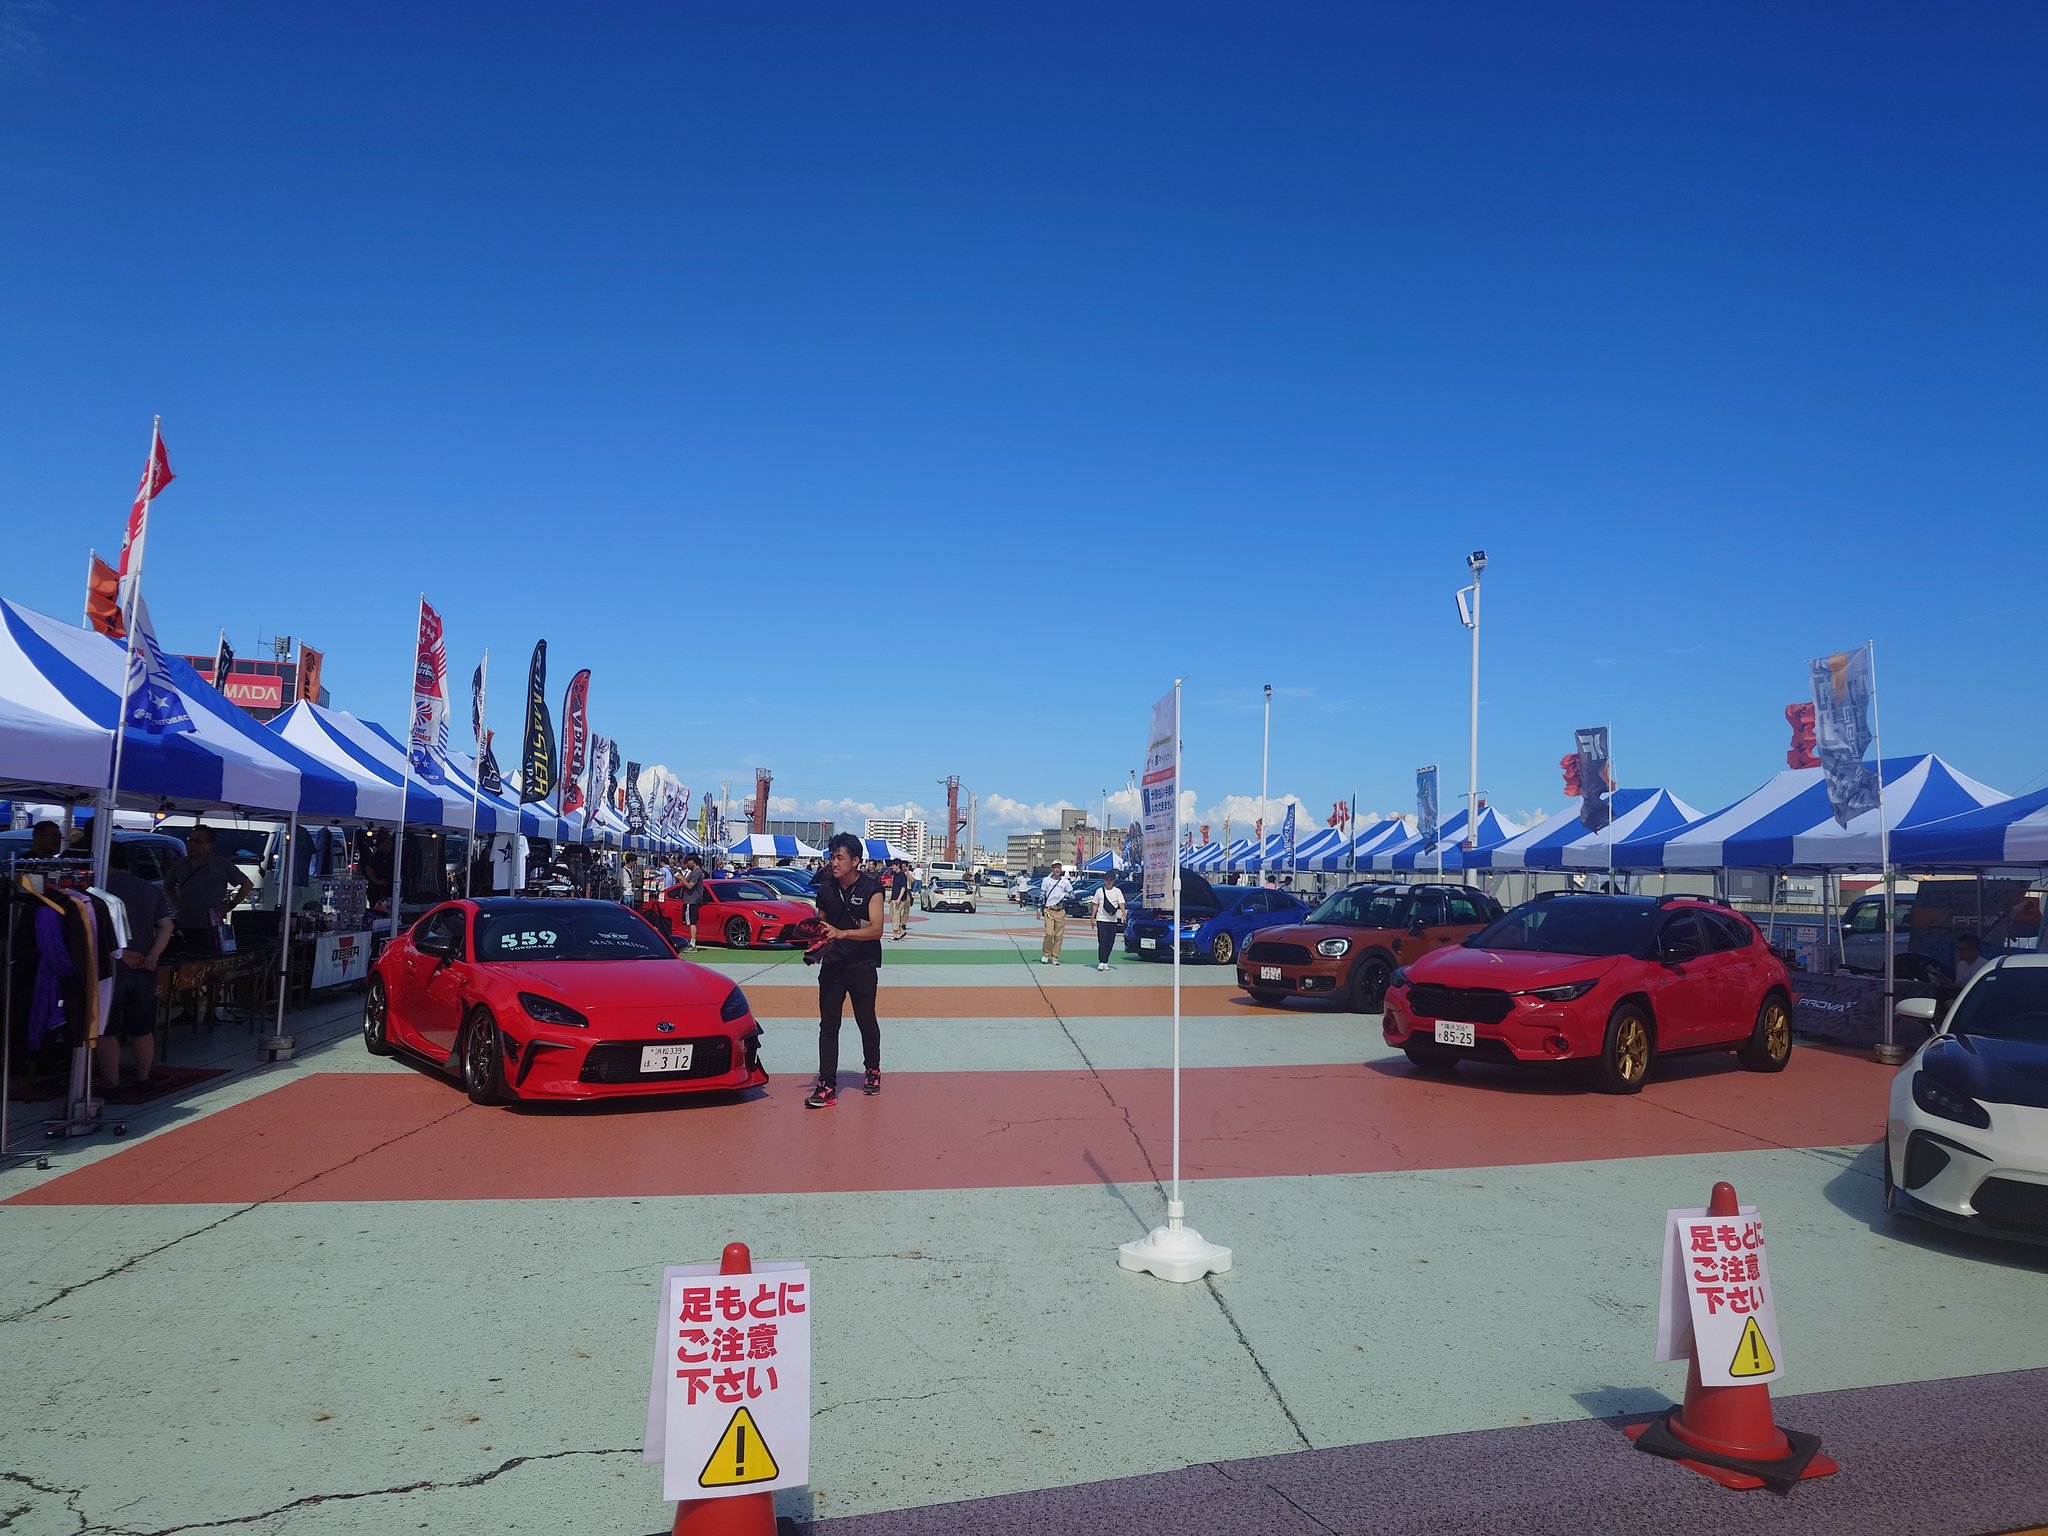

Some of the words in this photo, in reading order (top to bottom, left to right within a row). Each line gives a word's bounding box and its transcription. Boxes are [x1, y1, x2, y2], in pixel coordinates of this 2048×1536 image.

[223, 684, 278, 701] MADA
[569, 709, 583, 784] VERTE
[331, 945, 360, 962] DELTA
[501, 930, 557, 949] 559
[1798, 998, 1845, 1012] PROVA
[1444, 1030, 1472, 1045] 85-25
[1690, 1221, 1765, 1253] 足もとに
[1693, 1253, 1761, 1283] ご注意
[678, 1282, 806, 1324] 足もとに
[1696, 1285, 1765, 1315] 下さい
[676, 1323, 778, 1364] ご注意
[676, 1366, 779, 1405] 下さい
